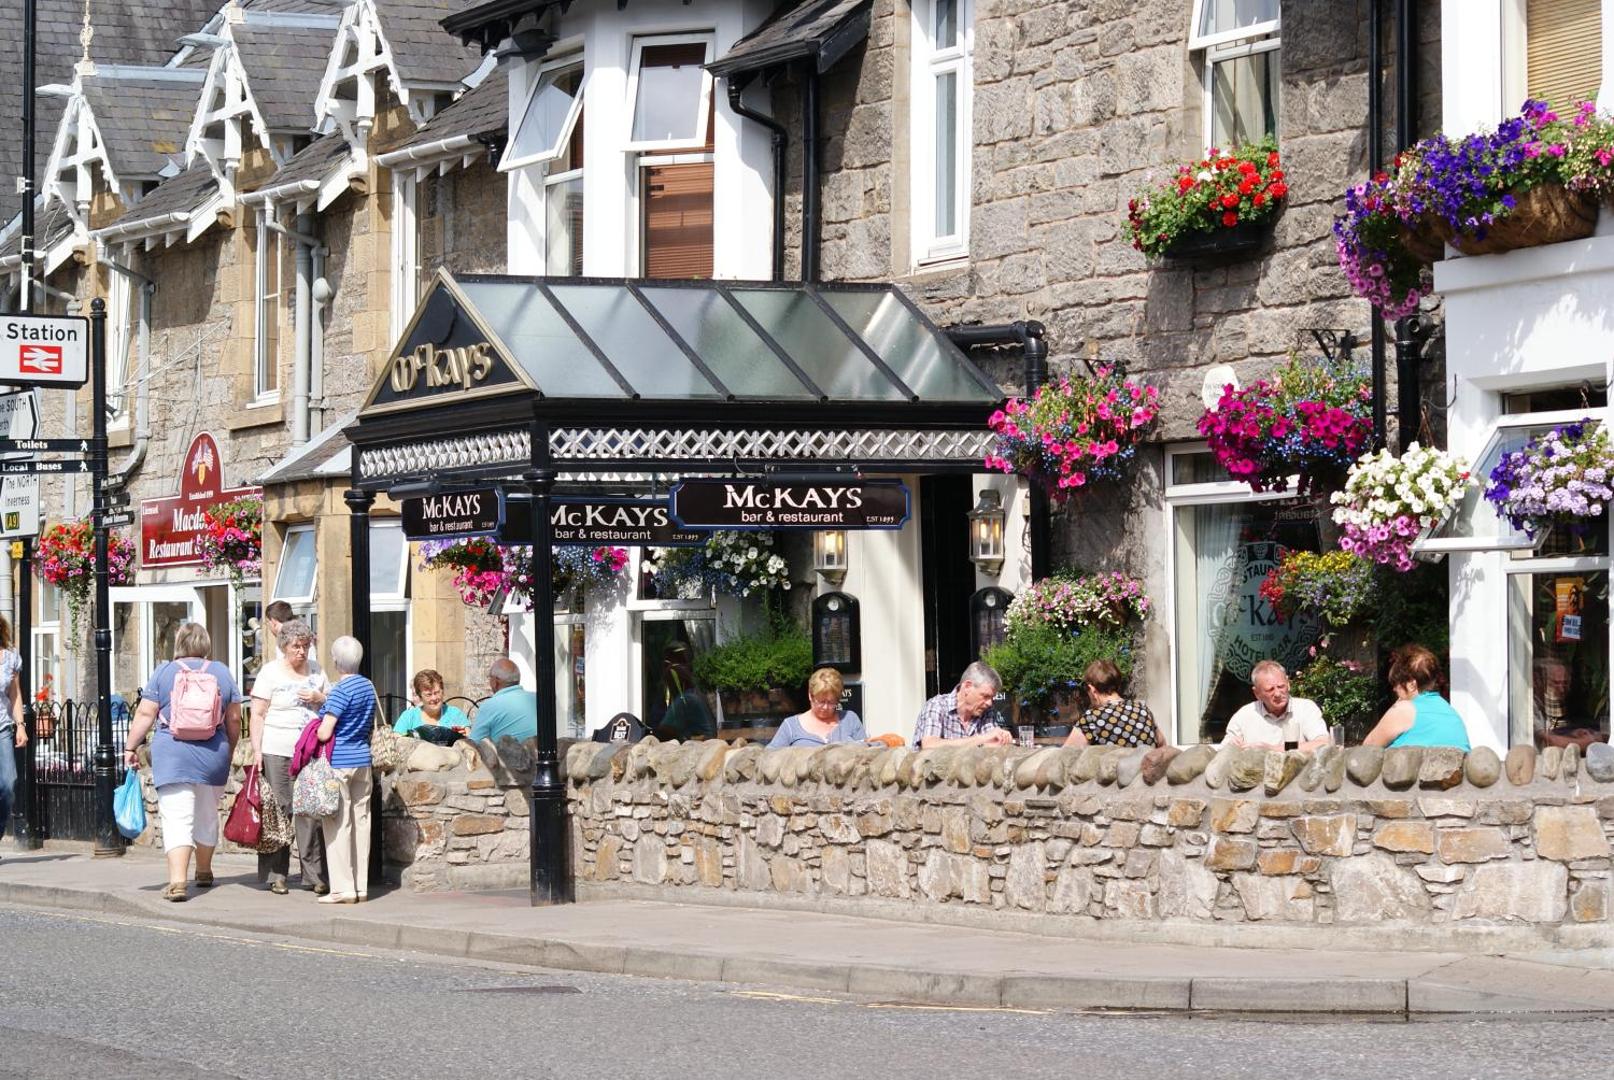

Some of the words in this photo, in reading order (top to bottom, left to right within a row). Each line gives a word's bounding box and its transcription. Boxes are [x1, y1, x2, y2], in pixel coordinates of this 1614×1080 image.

[6, 322, 78, 342] Station
[6, 397, 27, 412] SOUTH
[15, 440, 48, 450] Toilets
[2, 463, 28, 472] Local
[36, 462, 62, 471] Buses
[17, 474, 37, 488] NORTH
[5, 496, 30, 507] Inverness
[422, 493, 481, 520] McKAYS
[741, 510, 761, 523] bar
[766, 511, 774, 523] &
[778, 511, 844, 523] restaurant
[430, 521, 439, 533] bar
[445, 519, 473, 531] restaurant
[554, 528, 575, 539] bar
[578, 529, 587, 540] &
[590, 529, 652, 540] restaurant
[149, 538, 194, 559] Restaurant
